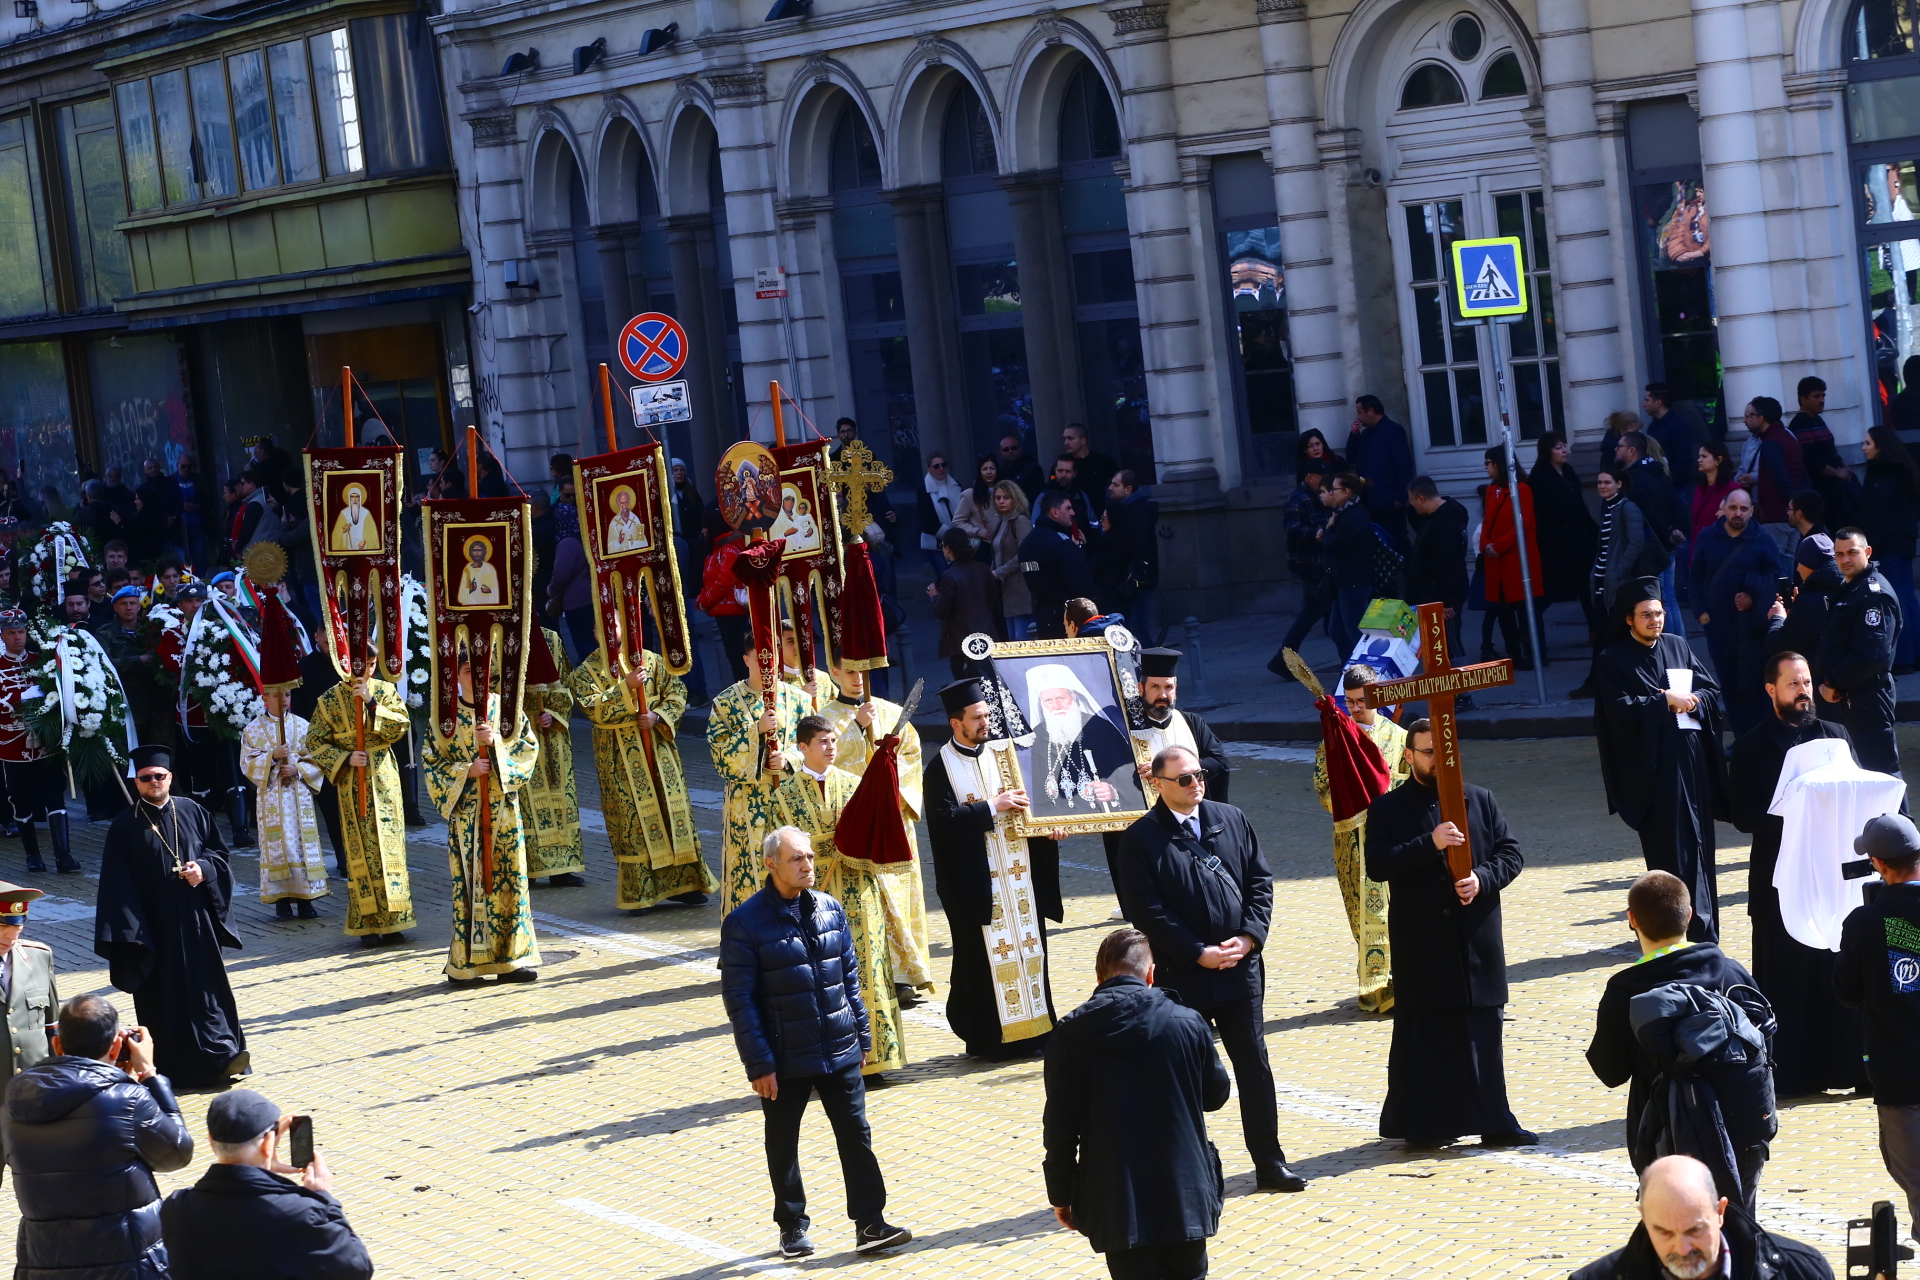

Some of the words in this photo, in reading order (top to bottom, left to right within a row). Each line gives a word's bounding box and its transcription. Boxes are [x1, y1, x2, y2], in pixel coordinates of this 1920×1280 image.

[1431, 611, 1443, 667] 1945
[1382, 681, 1417, 702] НЕОФИТ
[1418, 673, 1461, 695] ПАТРИАРХ
[1461, 665, 1508, 688] БЪЛГАРСКИ
[1442, 713, 1456, 768] 2024
